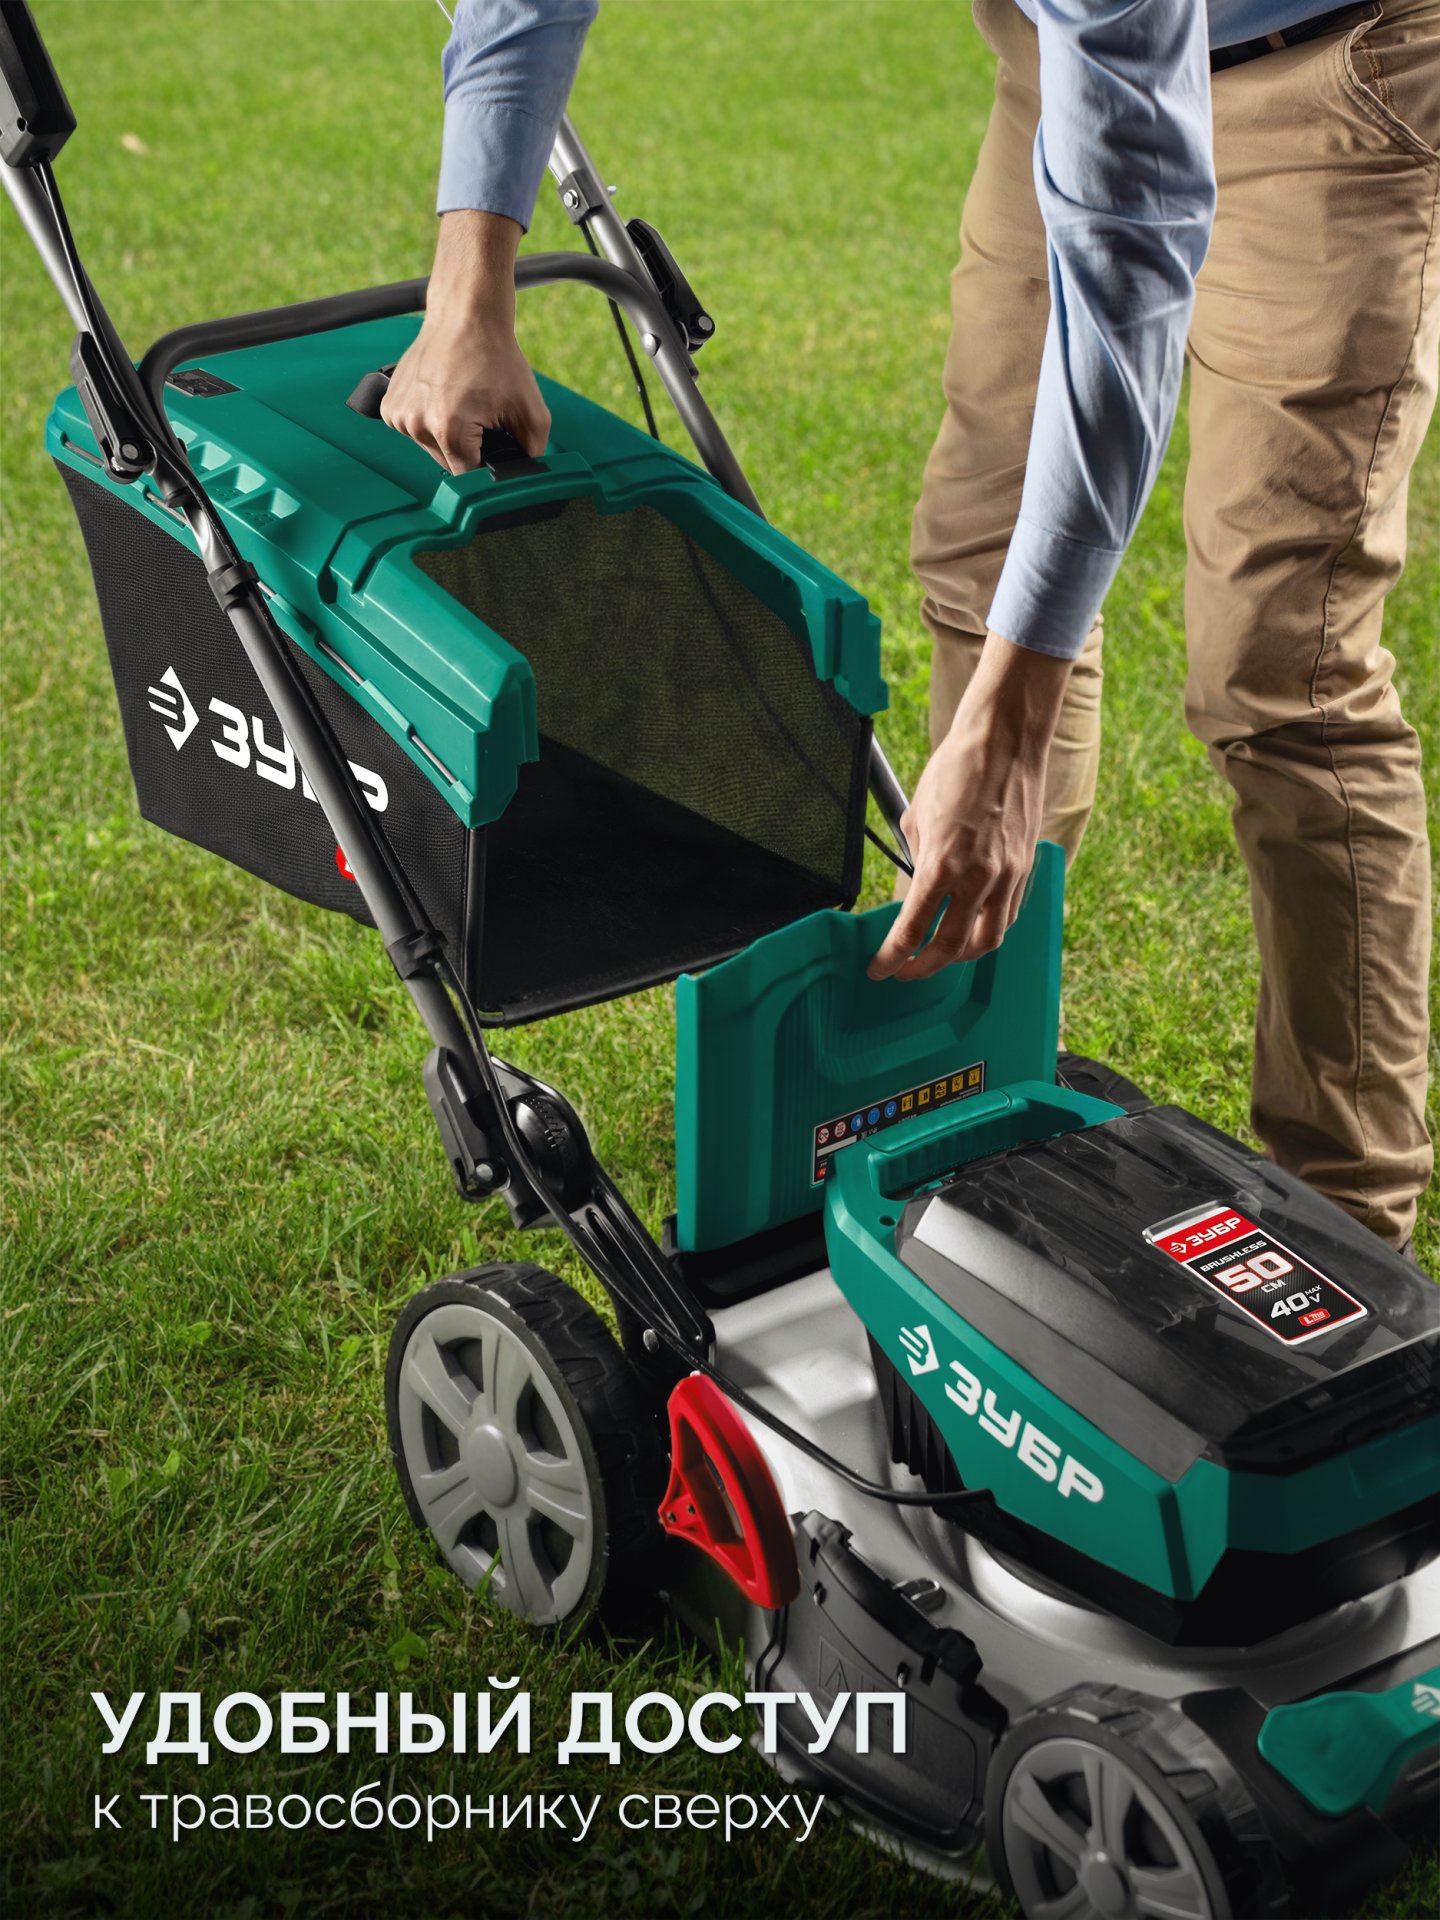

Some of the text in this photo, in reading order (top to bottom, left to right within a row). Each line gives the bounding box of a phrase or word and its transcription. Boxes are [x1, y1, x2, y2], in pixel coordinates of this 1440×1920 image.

[208, 697, 388, 812] ЗУР
[1185, 1216, 1241, 1247] ЗУБР
[1200, 1240, 1267, 1272] BRUSHLESS
[1212, 1251, 1295, 1294] 50
[1270, 1292, 1321, 1319] 40 V
[1304, 1285, 1322, 1296] MAX
[944, 1360, 1104, 1503] ЗУБР
